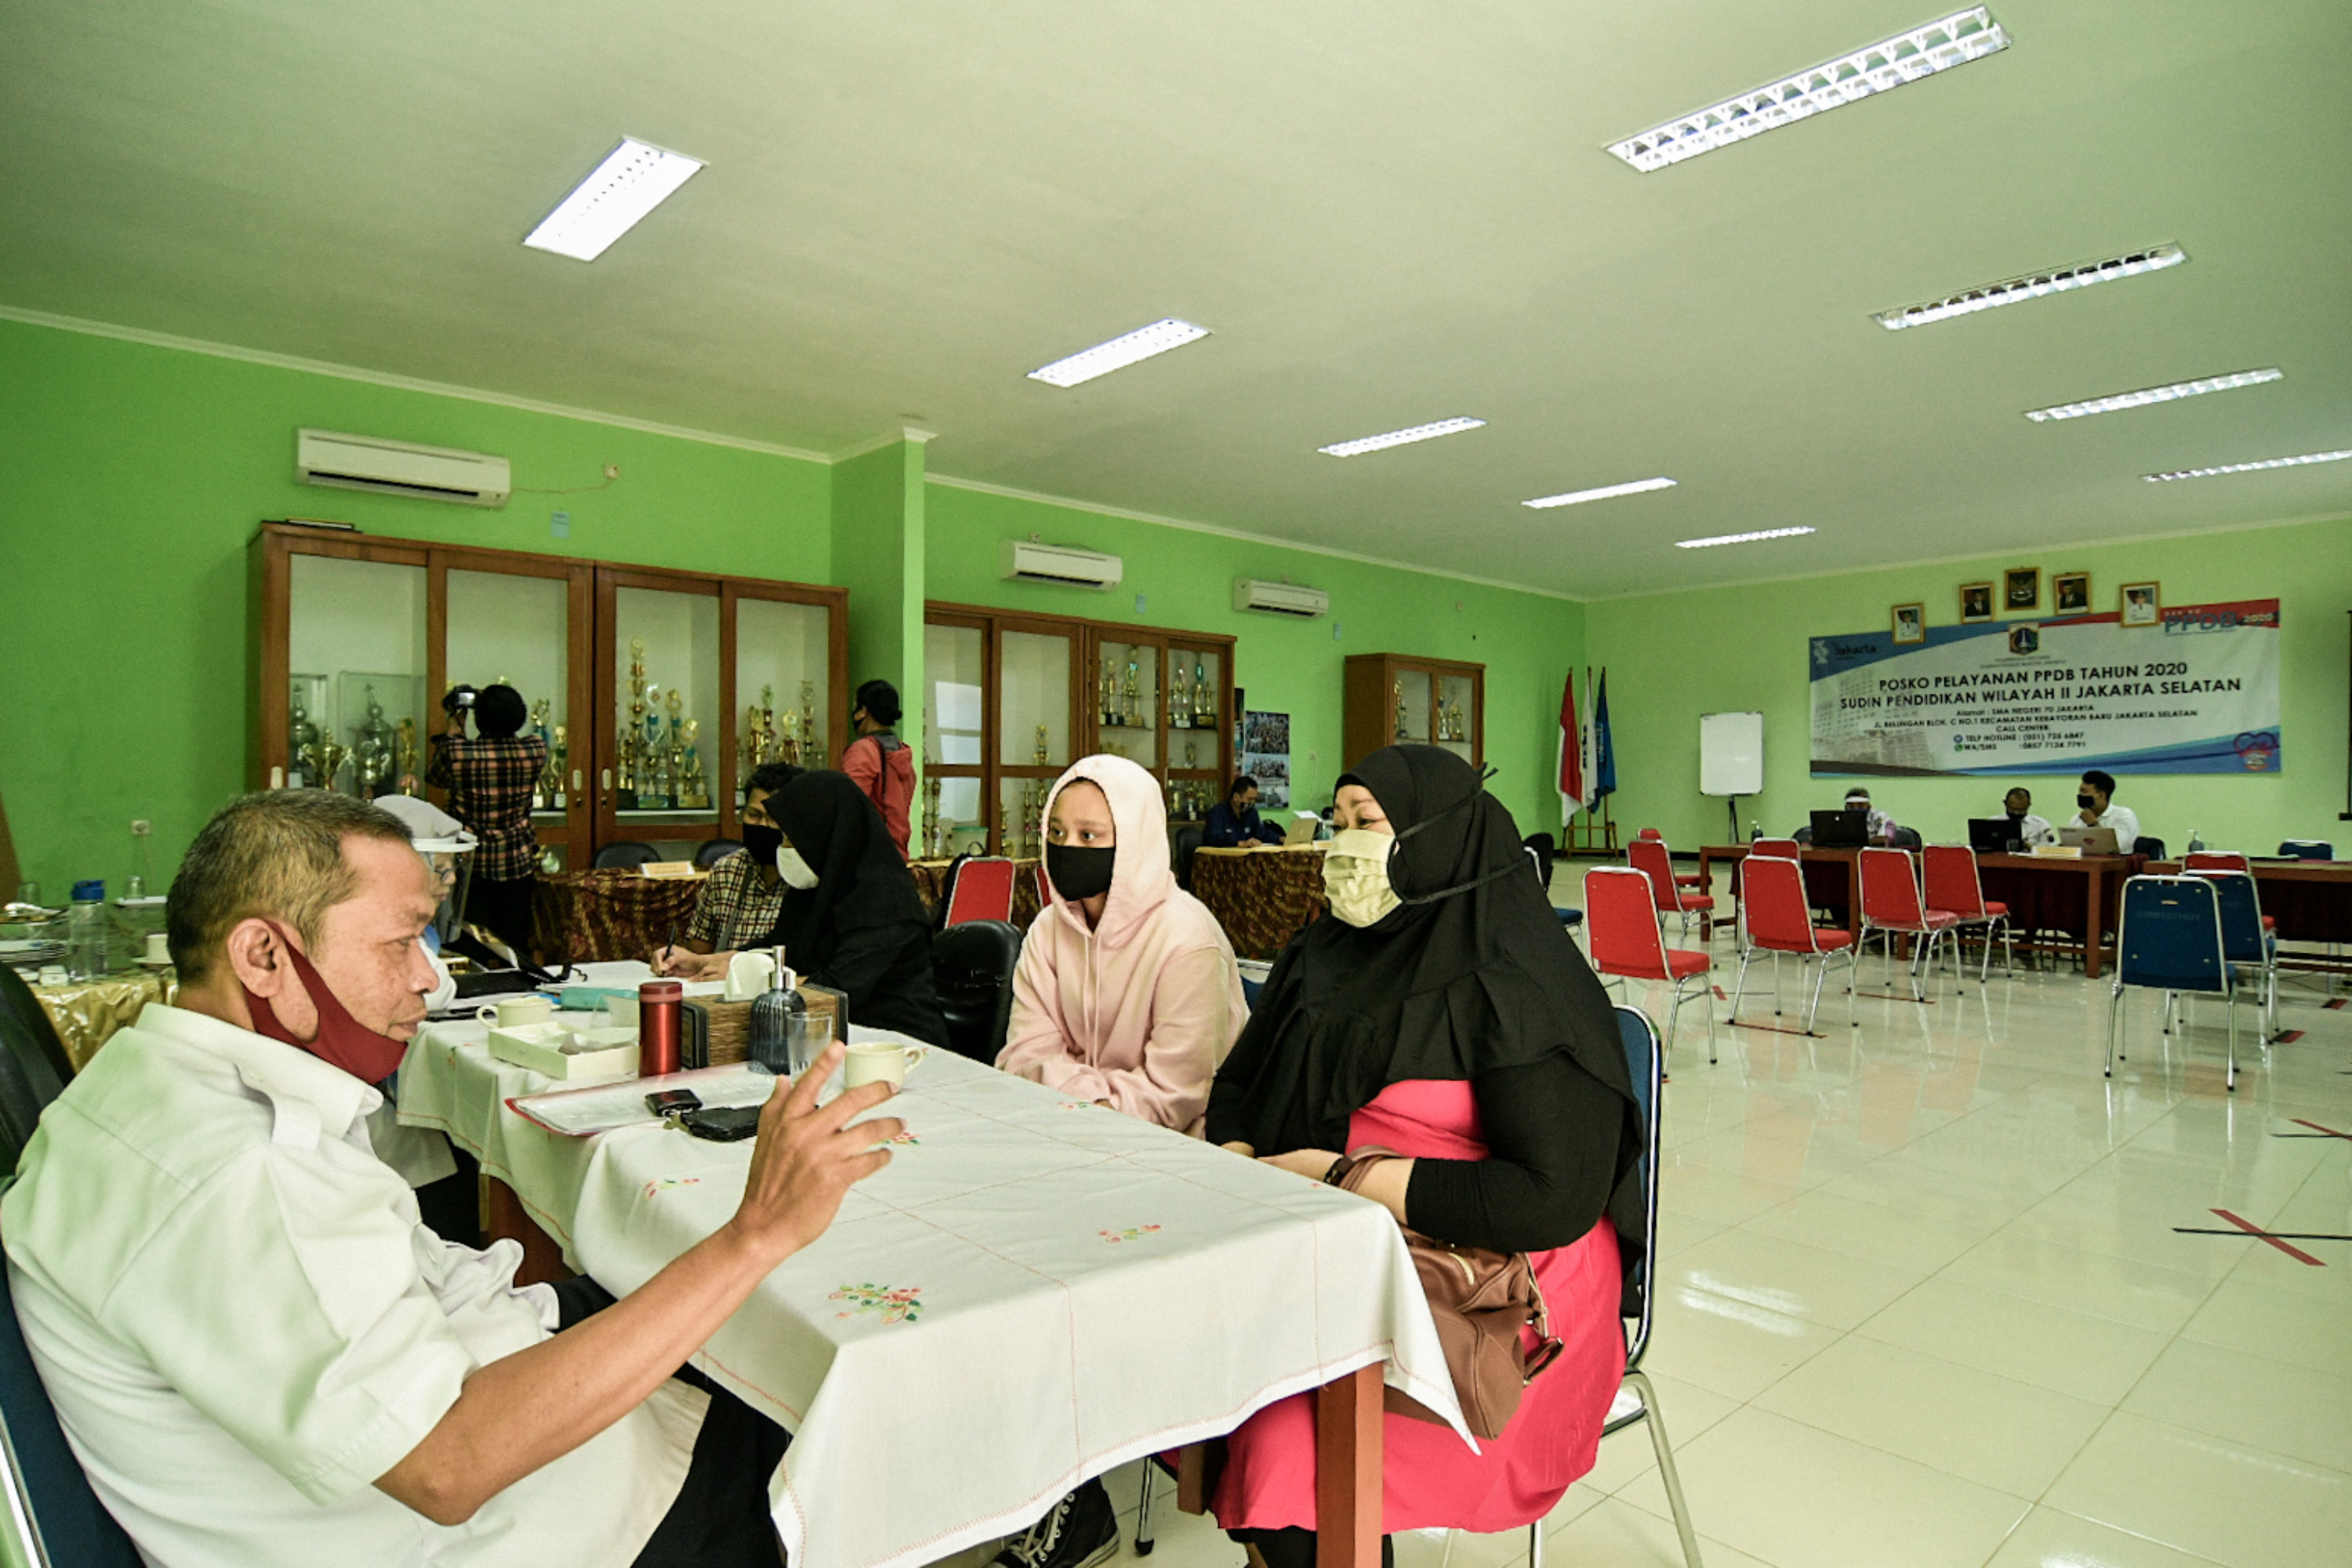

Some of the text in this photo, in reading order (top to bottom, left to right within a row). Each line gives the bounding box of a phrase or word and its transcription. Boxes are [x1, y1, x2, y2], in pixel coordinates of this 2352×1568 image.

[2165, 612, 2237, 632] PPDB
[1879, 677, 1929, 691] POSKO
[1934, 671, 2028, 688] PELAYANAN
[2034, 669, 2074, 682] PPDB
[2080, 664, 2138, 680] TAHUN
[2144, 662, 2187, 677] 2020
[1840, 677, 2241, 709] SUDIN PENDIDIKAN WILAYAH II JAKARTA SELATAN
[1980, 716, 2031, 724] KECAMATAN
[2158, 710, 2198, 718] SELATAN
